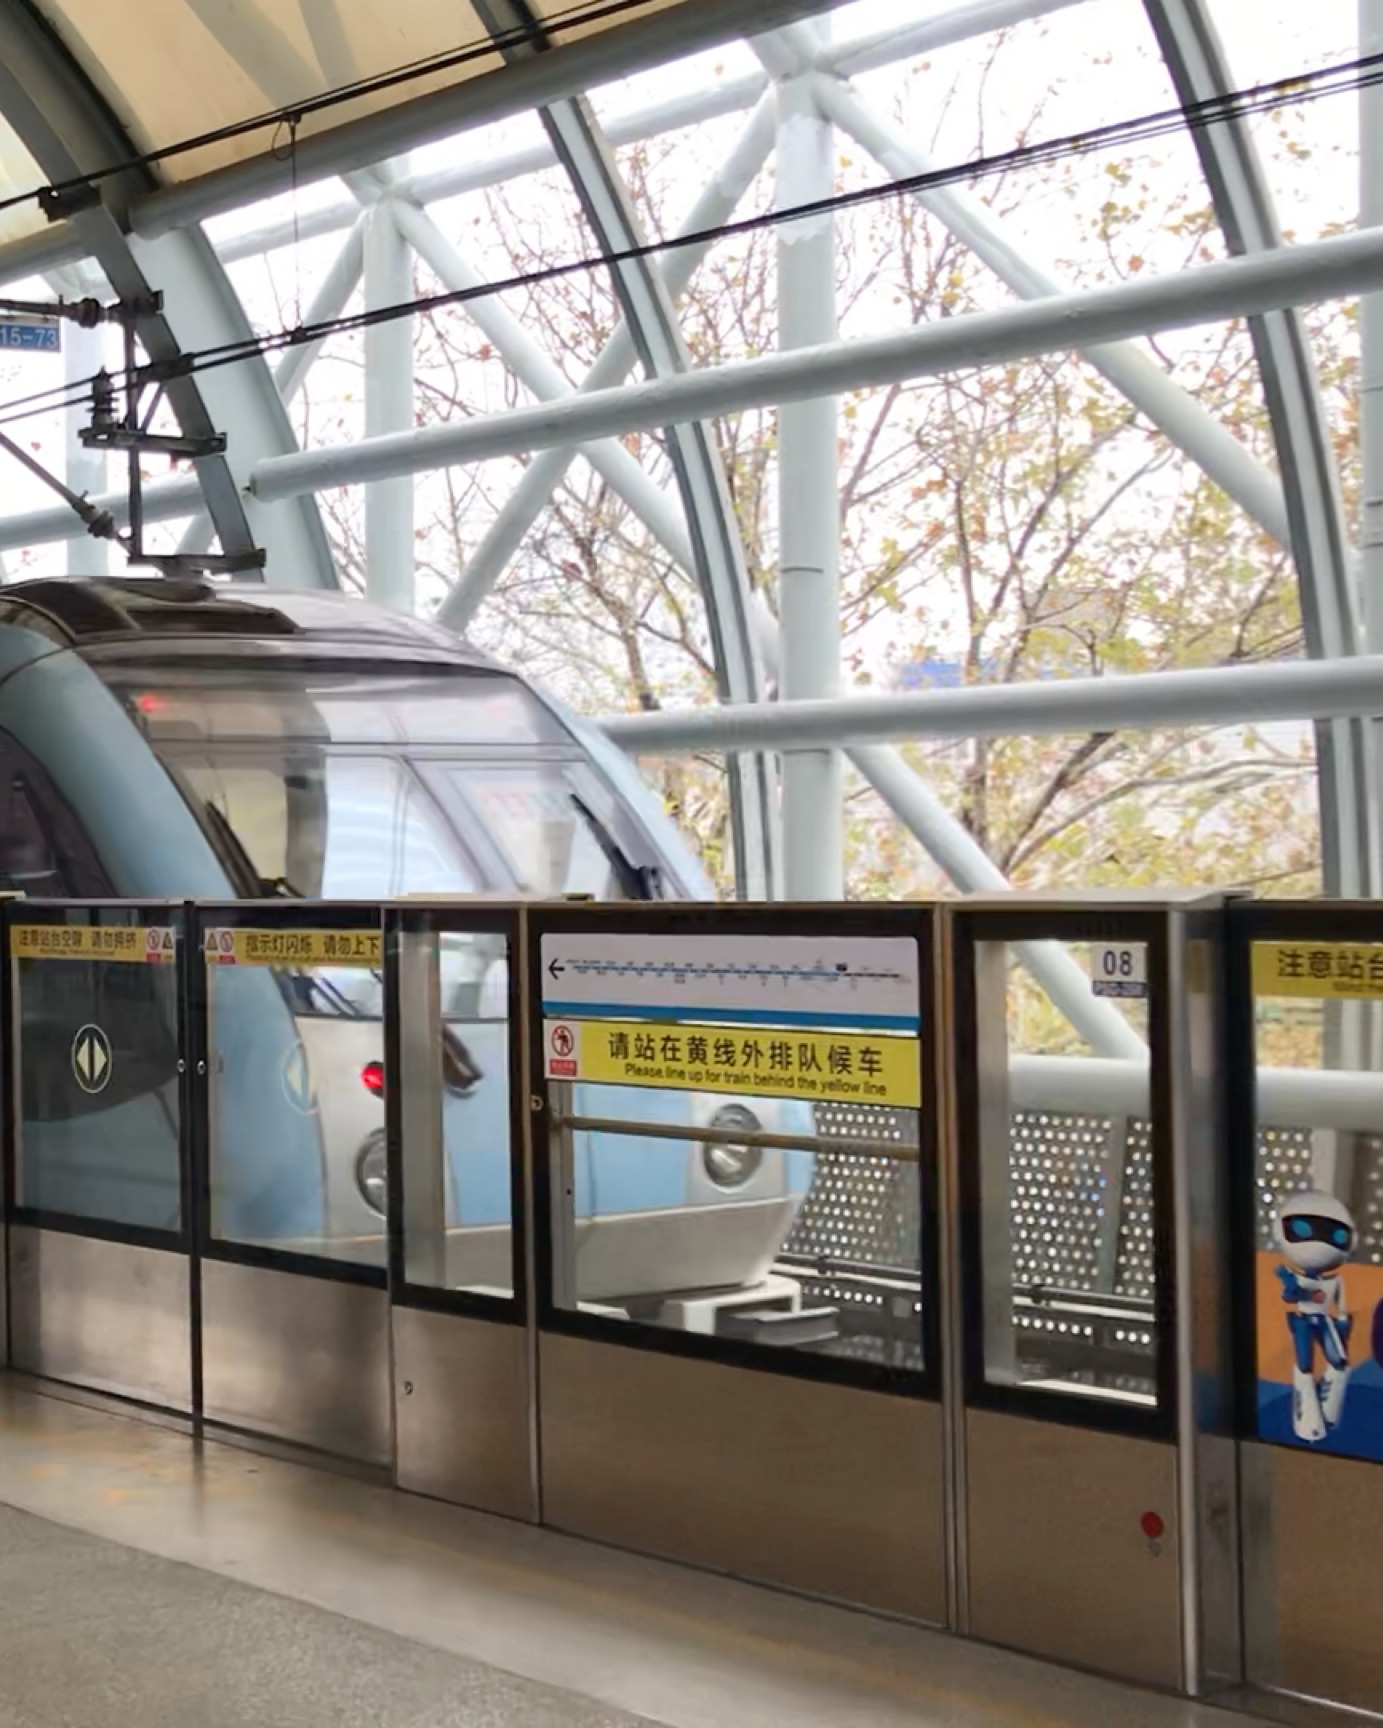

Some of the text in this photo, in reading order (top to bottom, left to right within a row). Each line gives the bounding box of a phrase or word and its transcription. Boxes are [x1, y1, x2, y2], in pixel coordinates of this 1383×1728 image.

[0, 326, 57, 350] 15-73
[1103, 950, 1132, 976] 08
[608, 1031, 883, 1077] 请站在黄线外排队候车
[665, 1066, 685, 1080] line
[688, 1070, 702, 1082] up
[705, 1069, 721, 1082] for
[724, 1070, 751, 1083] train
[754, 1072, 795, 1088] behind
[797, 1077, 817, 1091] the
[820, 1079, 860, 1094] yellow
[863, 1081, 887, 1096] line
